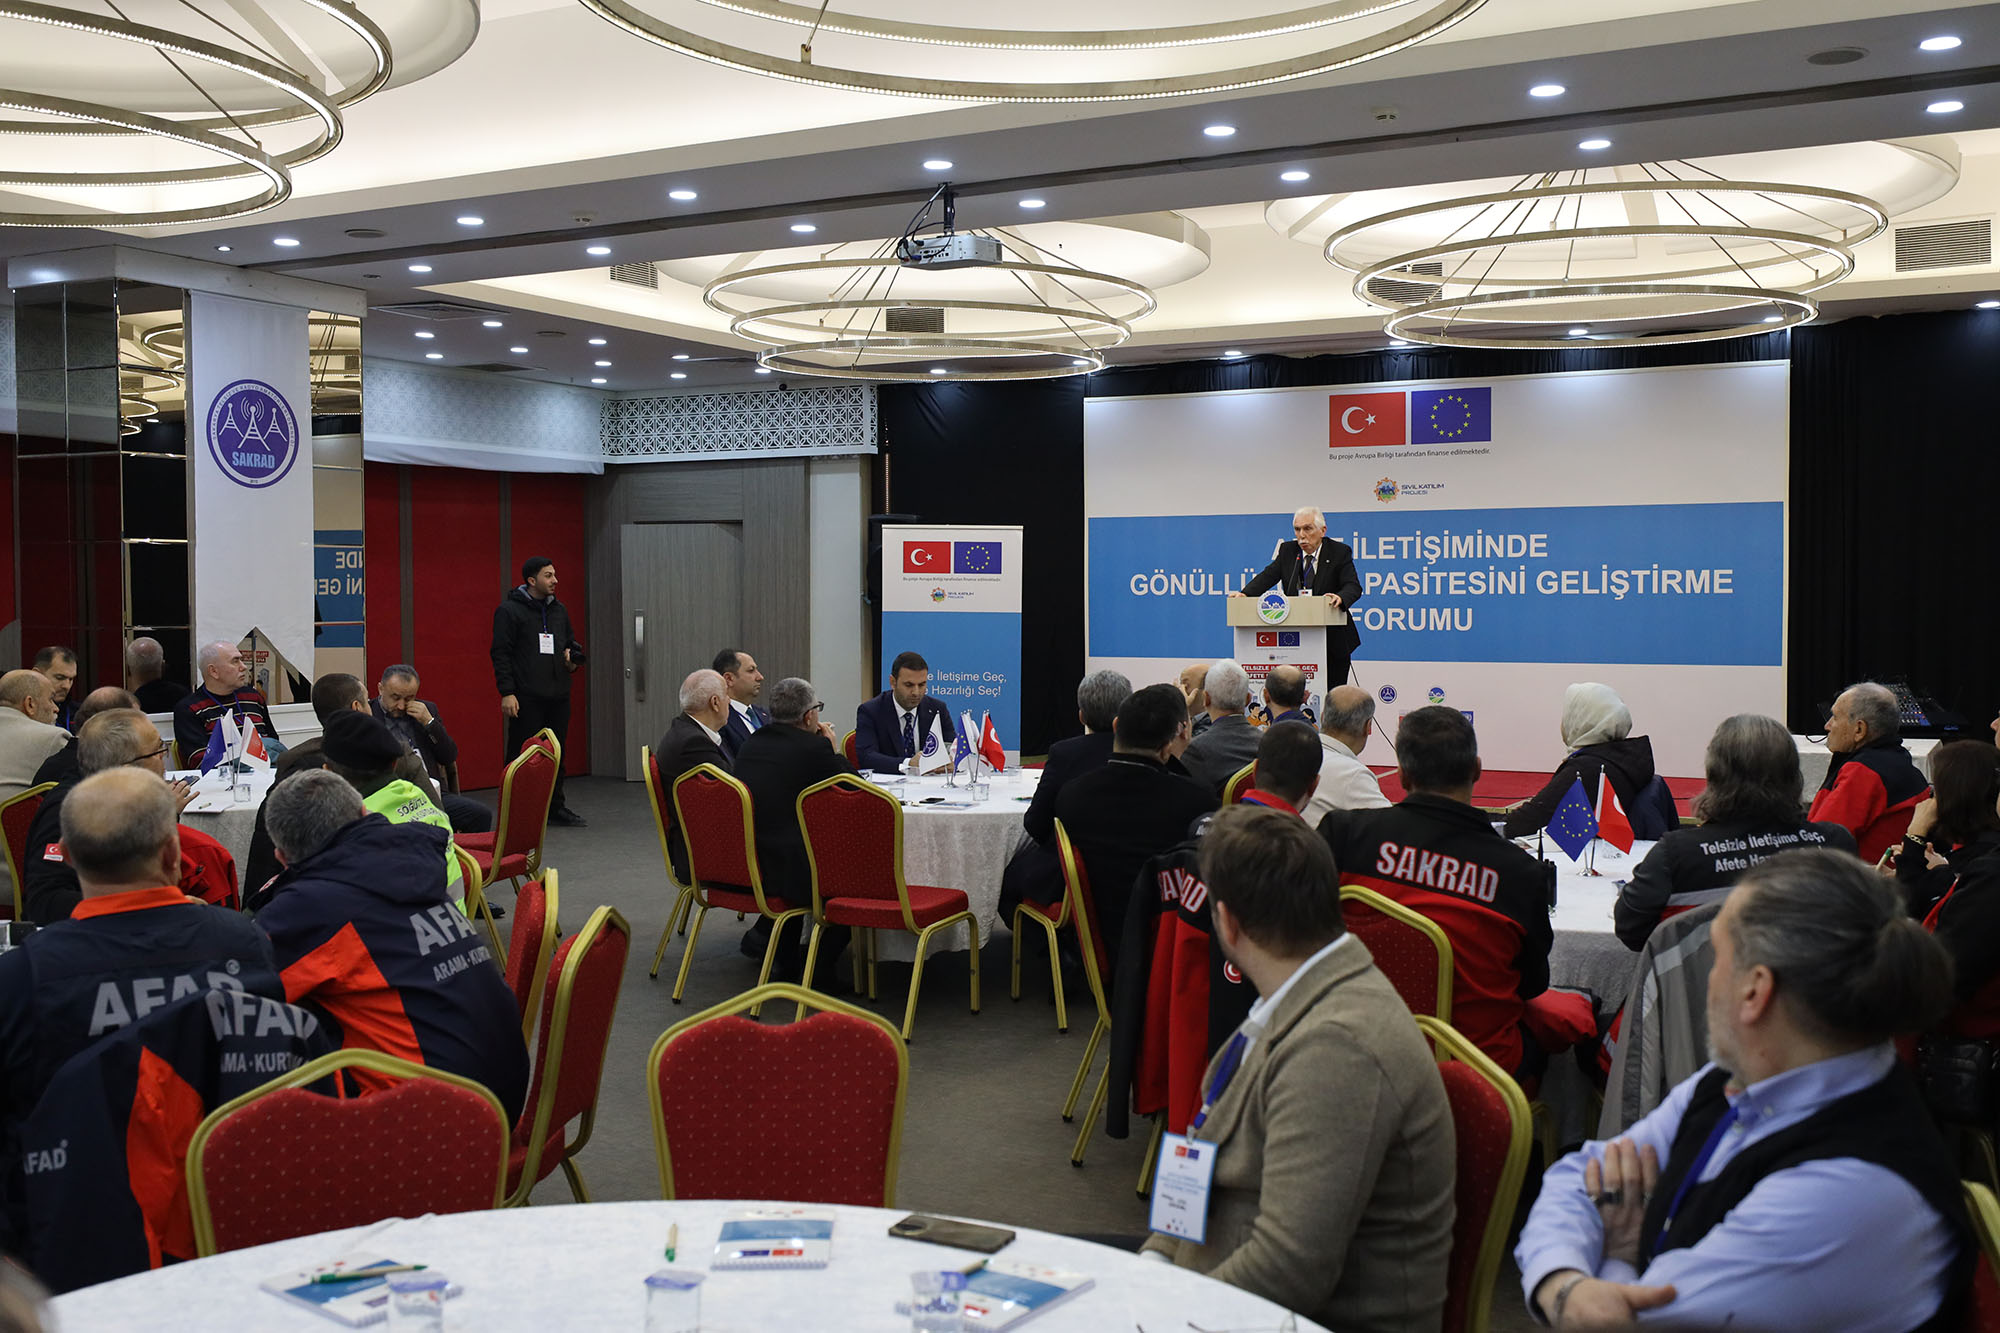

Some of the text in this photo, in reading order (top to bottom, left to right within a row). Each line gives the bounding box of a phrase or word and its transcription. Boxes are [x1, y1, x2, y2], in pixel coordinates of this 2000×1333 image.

[232, 451, 276, 469] SAKRAD
[1338, 453, 1353, 461] proje
[1354, 453, 1376, 461] Avrupa
[1377, 451, 1395, 460] Birliği
[1427, 449, 1450, 457] finanse
[1352, 529, 1548, 564] İLETİŞİMİNDE
[1130, 564, 1734, 600] GÖNÜLLÜ PASİTESİNİ GELİŞTİRME
[937, 669, 980, 684] İletişime
[982, 671, 1007, 684] Geç,
[931, 684, 975, 698] Hazırlığı
[978, 684, 1002, 698] Seç!
[1700, 838, 1747, 856] Telsizle
[1748, 831, 1799, 849] İletişime
[1376, 841, 1499, 903] SAKRAD
[1715, 856, 1747, 873] Afete
[409, 902, 477, 956] AFA
[433, 953, 469, 982] ARAMA
